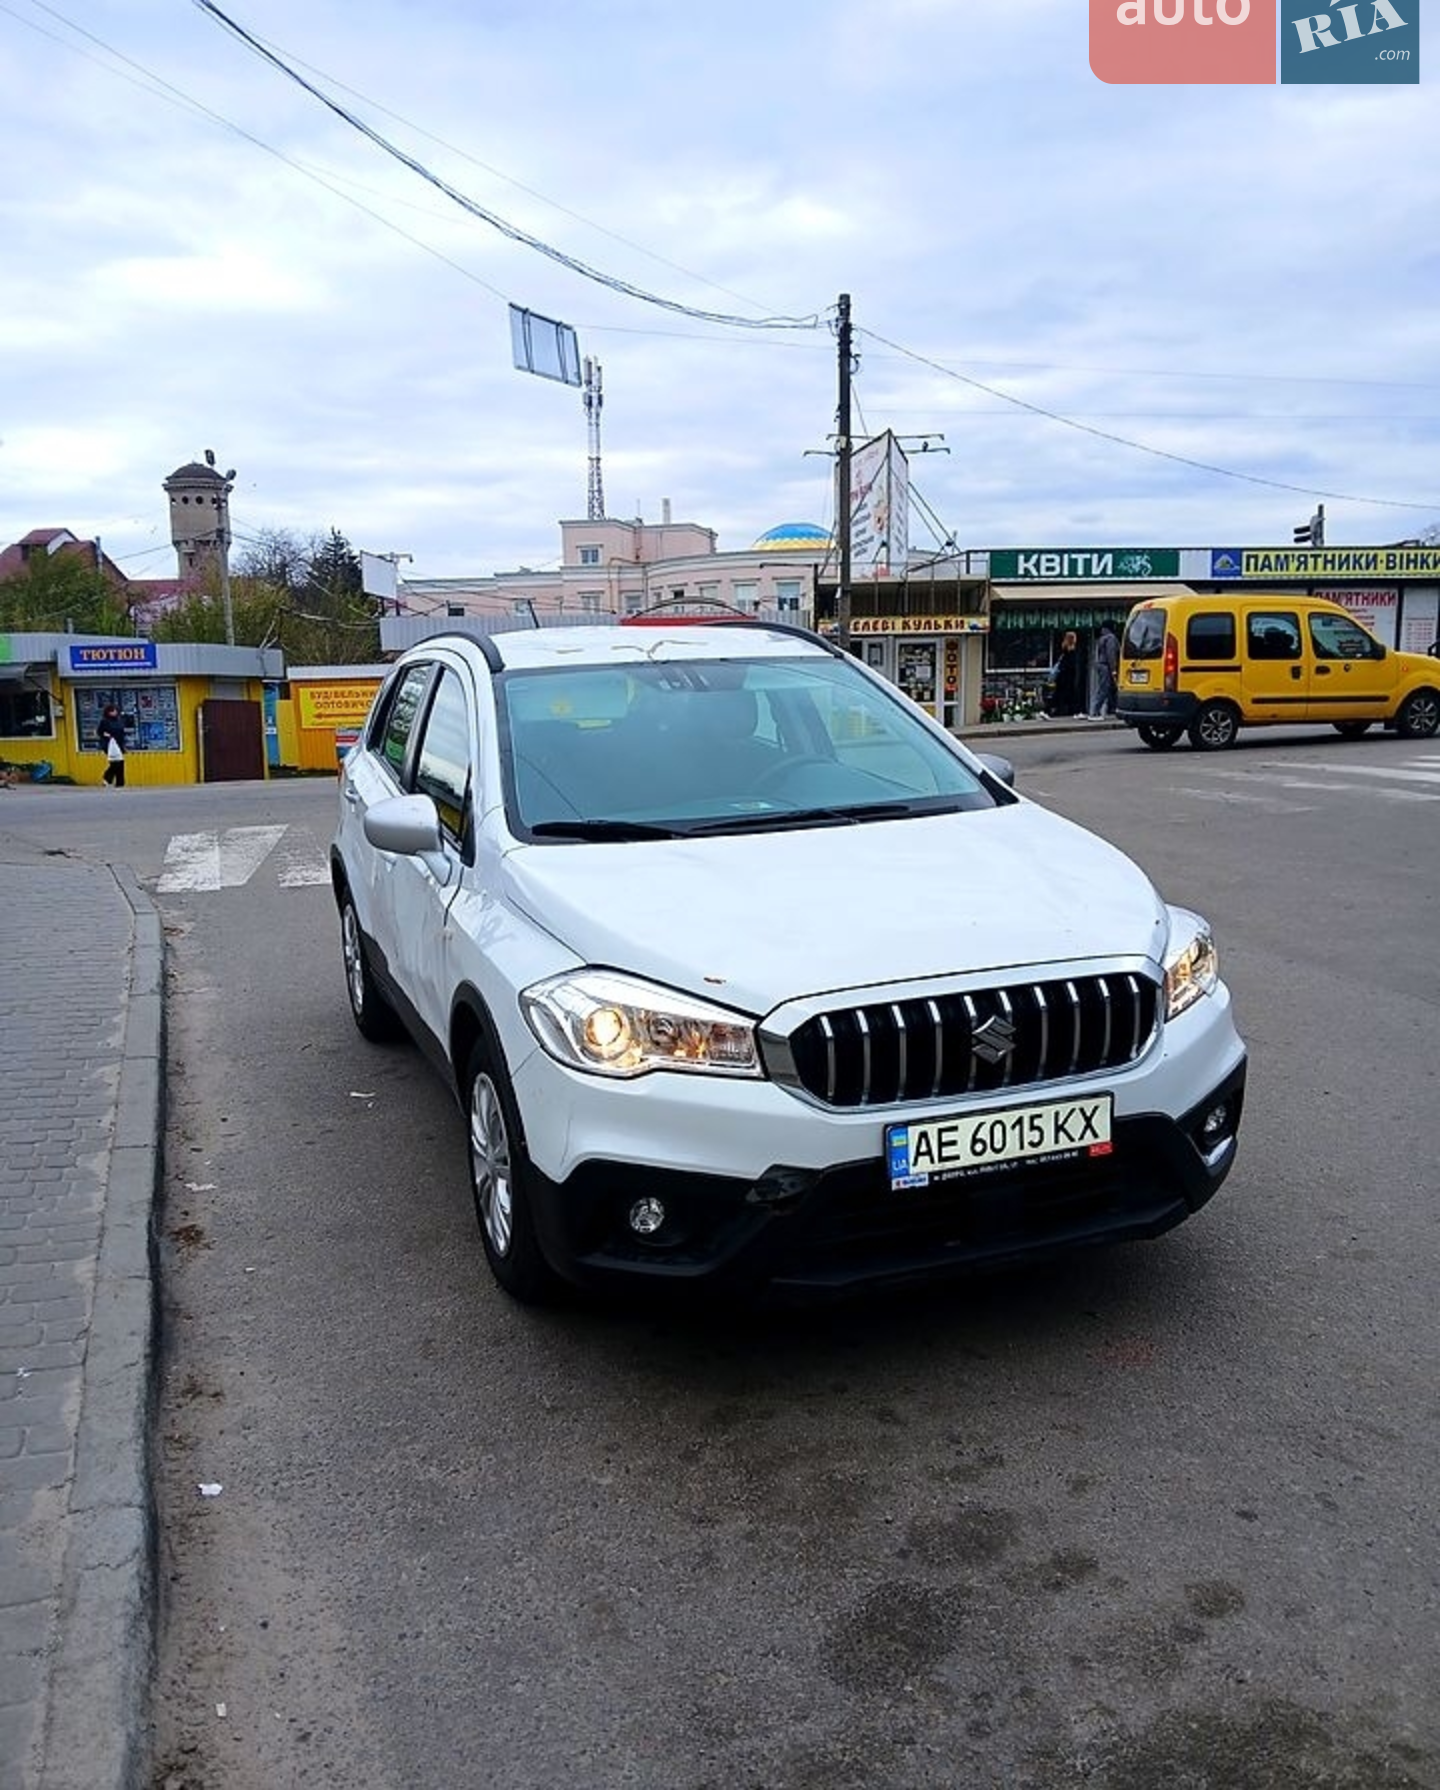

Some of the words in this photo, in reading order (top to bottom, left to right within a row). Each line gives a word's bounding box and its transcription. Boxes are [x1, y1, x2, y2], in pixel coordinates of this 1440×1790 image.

[1017, 553, 1113, 576] КВІТИ
[901, 618, 965, 631] КУЛЬКИ
[79, 647, 146, 661] ТЮТЮН
[912, 1126, 960, 1167] AE
[970, 1113, 1044, 1157] 6015
[1053, 1105, 1101, 1145] KX
